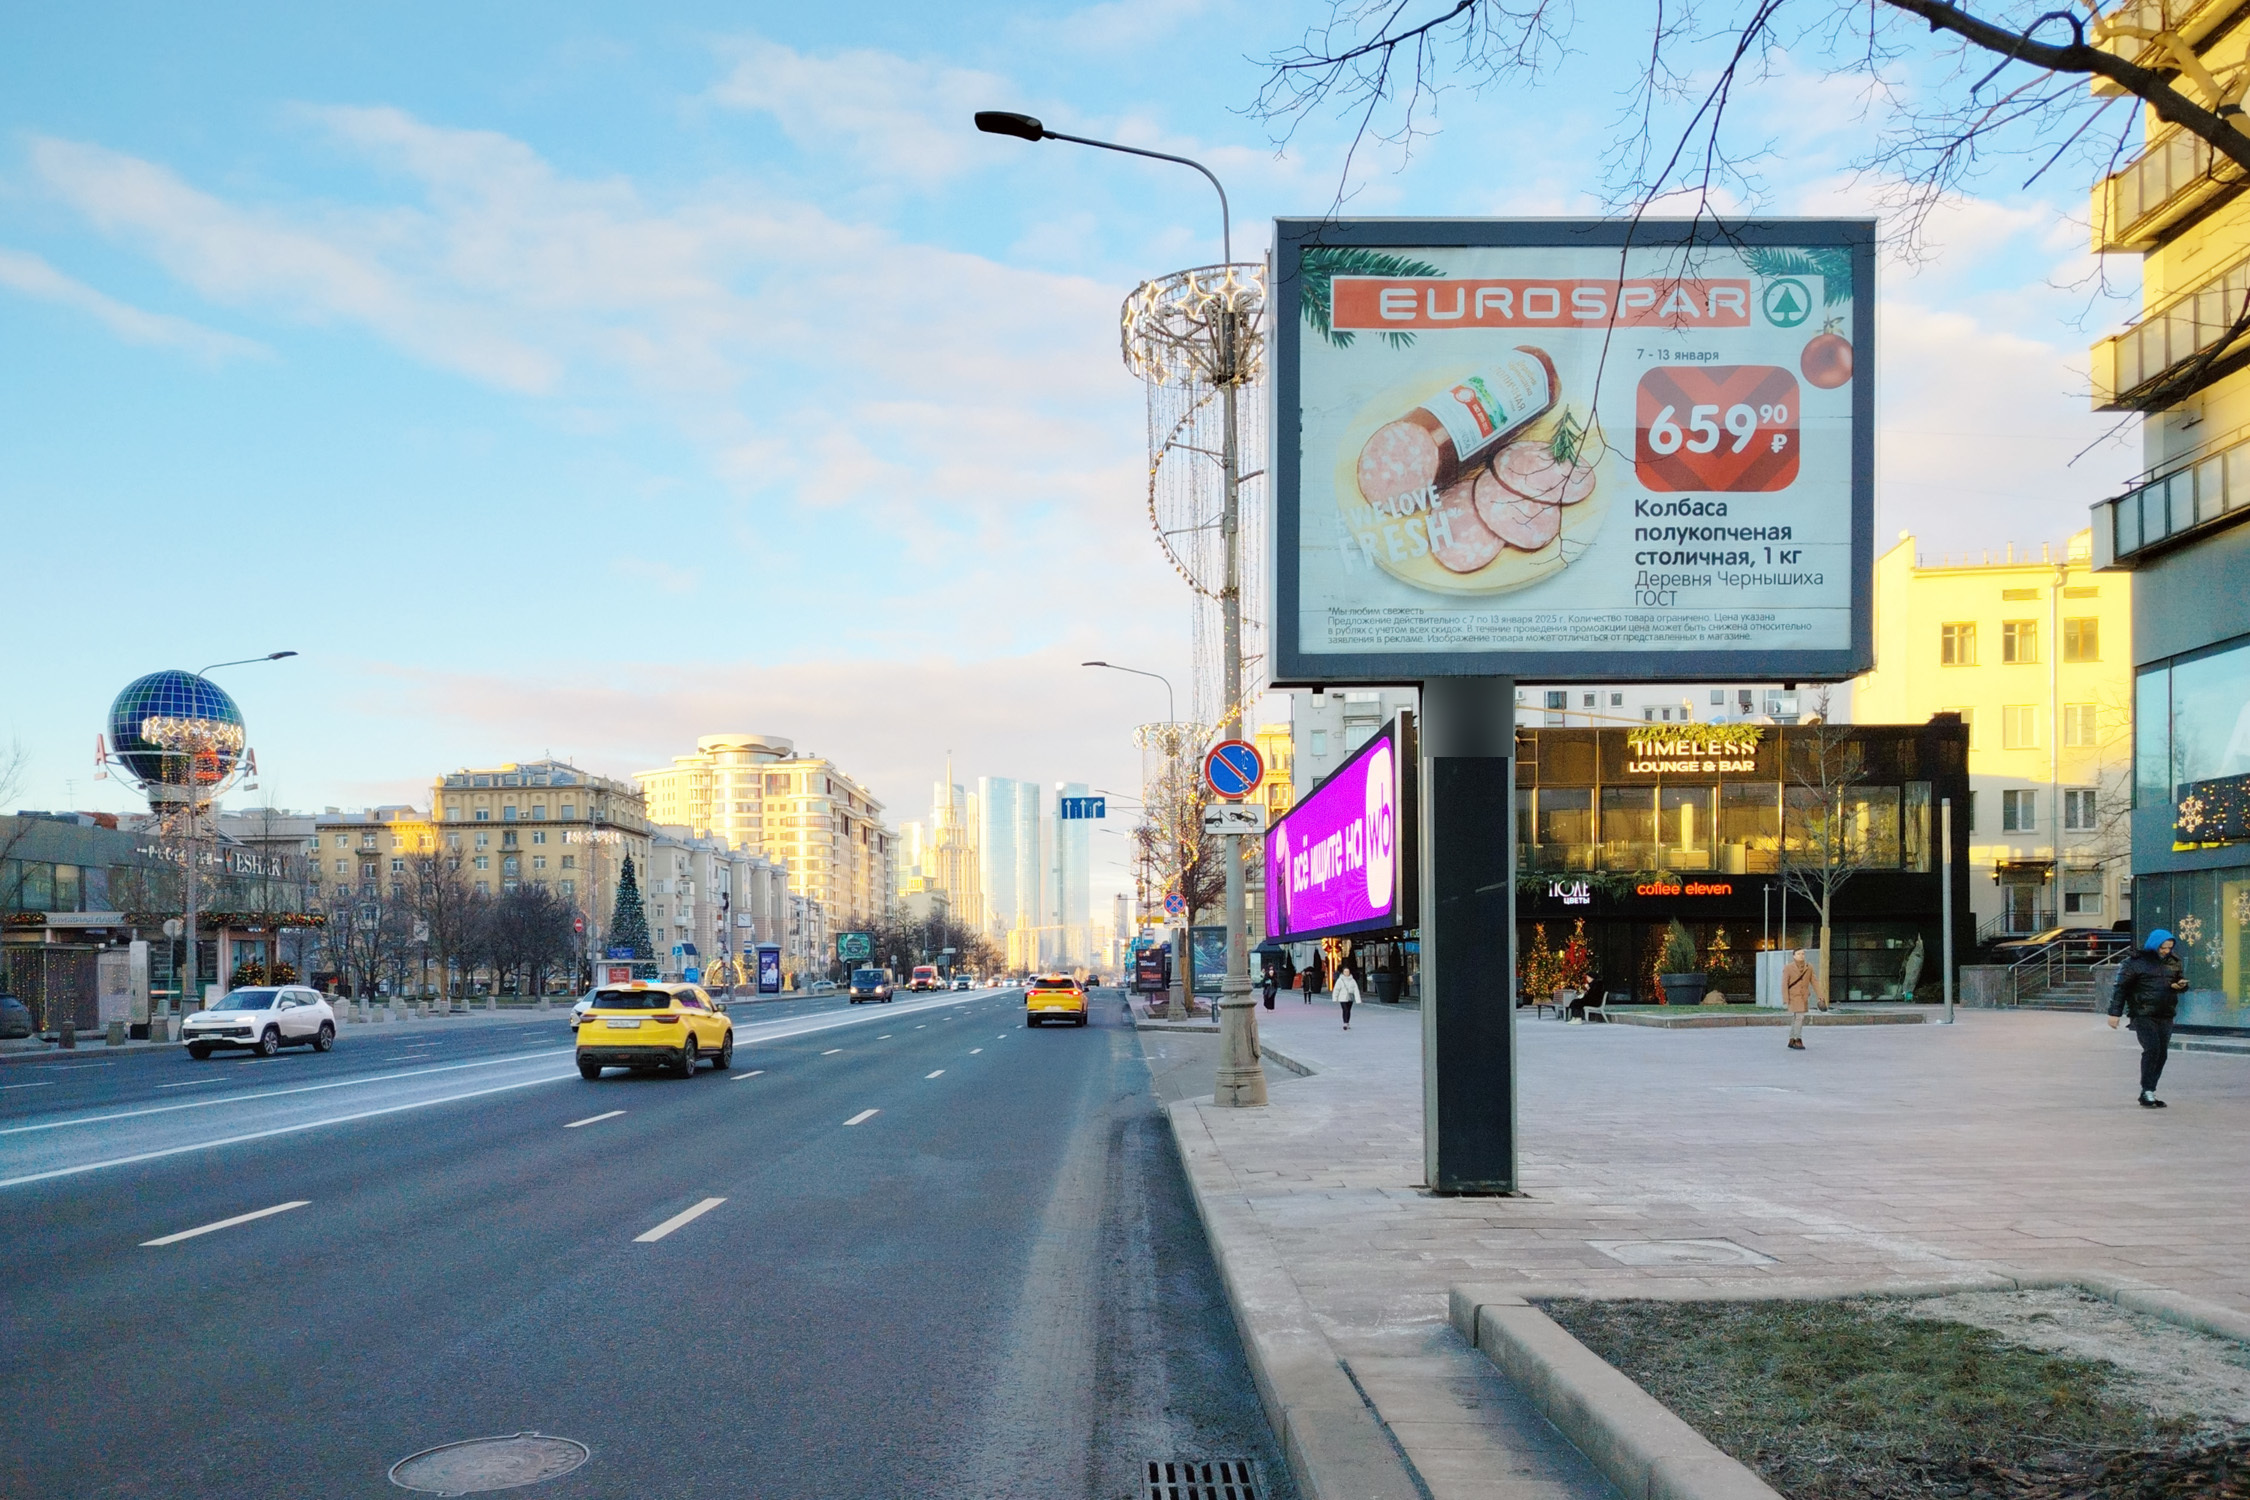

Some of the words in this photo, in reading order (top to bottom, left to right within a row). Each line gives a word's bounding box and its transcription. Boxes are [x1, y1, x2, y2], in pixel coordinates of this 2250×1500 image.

[1379, 286, 1746, 320] EUROSPAR
[1636, 349, 1645, 360] 7
[1657, 349, 1670, 360] 13
[1674, 350, 1720, 363] января
[1648, 403, 1758, 455] 659
[1759, 404, 1789, 424] 90
[1388, 482, 1442, 519] LOVE
[1635, 498, 1728, 517] Колбаса
[1635, 526, 1792, 545] полукопченая
[1635, 551, 1755, 568] столичная,
[1763, 546, 1772, 564] 1
[1779, 550, 1802, 565] кг
[1635, 570, 1712, 590] Деревня
[1717, 571, 1824, 590] Чернышиха
[1635, 590, 1678, 607] ГОСТ
[1328, 616, 1392, 627] Предложение
[1393, 616, 1460, 625] действительно
[1469, 615, 1474, 623] 7
[1490, 615, 1499, 623] 13
[1501, 616, 1533, 625] января
[1535, 614, 1557, 623] 2025
[1569, 614, 1622, 623] Количество
[1624, 615, 1654, 624] товара
[1656, 614, 1710, 624] ограничено.
[1714, 613, 1739, 622] Цена
[1741, 614, 1776, 622] указана
[1349, 607, 1380, 615] любим
[1382, 607, 1424, 615] свежесть
[1335, 626, 1366, 636] рублях
[1375, 626, 1407, 635] учетом
[1476, 625, 1511, 633] течение
[1513, 625, 1568, 634] проведения
[1569, 624, 1626, 633] промоакции
[1684, 623, 1706, 631] быть
[1708, 623, 1748, 631] снижена
[1750, 623, 1812, 631] относительно
[1328, 636, 1374, 644] заявления
[1376, 635, 1382, 643] в
[1384, 635, 1425, 645] рекламе.
[1427, 634, 1490, 643] Изображение
[1492, 635, 1524, 643] товара
[1557, 633, 1608, 641] отличаться
[1623, 633, 1697, 642] представленных
[1707, 633, 1752, 641] магазине.
[1633, 739, 1756, 756] TIMELESS
[1629, 761, 1700, 773] LOUNGE
[1702, 760, 1717, 772] &
[1718, 760, 1756, 772] BAR
[1367, 782, 1391, 863] wb
[1293, 834, 1309, 892] всё
[1310, 829, 1343, 892] ищите
[1345, 818, 1363, 872] на
[234, 853, 281, 877] ESHAK
[1685, 882, 1732, 896] eleven
[1563, 897, 1591, 905] ЦВЕТЫ
